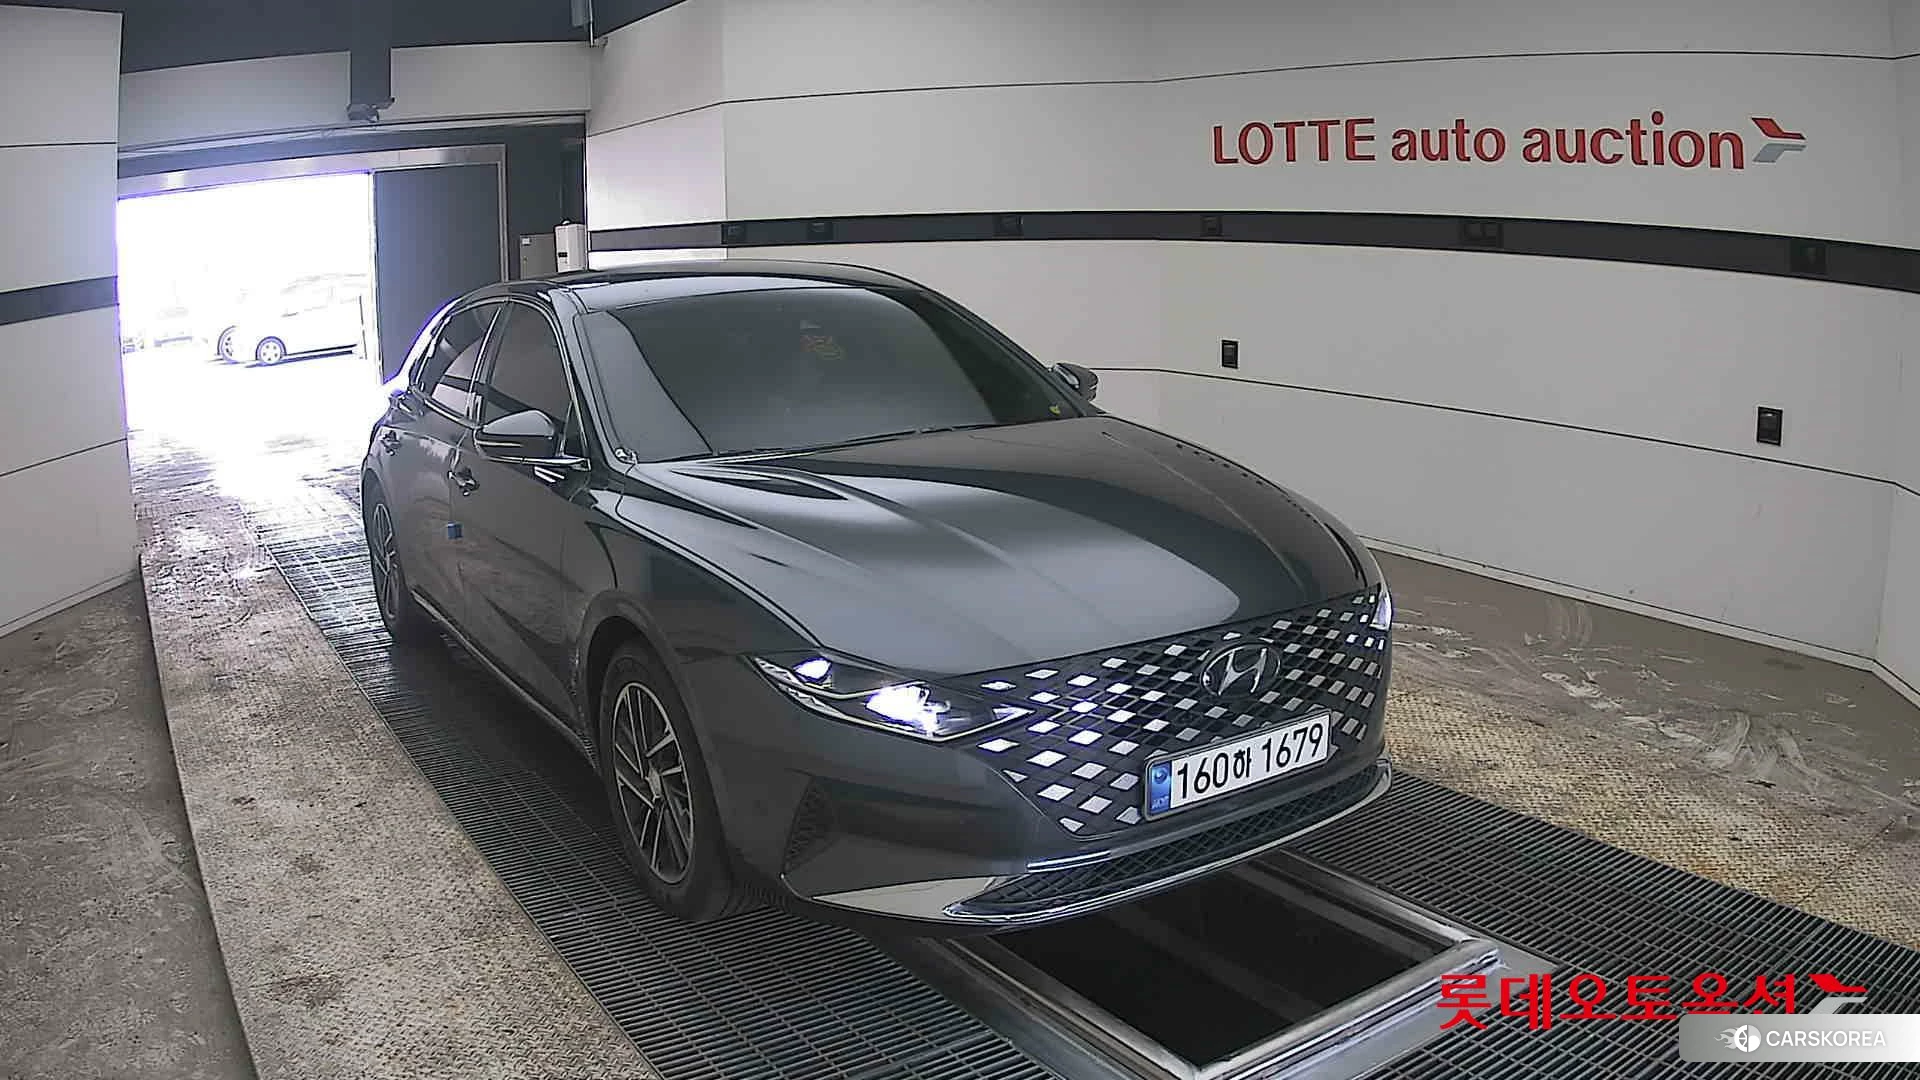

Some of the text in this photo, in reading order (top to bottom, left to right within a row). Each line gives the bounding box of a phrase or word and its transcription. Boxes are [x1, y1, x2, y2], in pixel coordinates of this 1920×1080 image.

[1212, 111, 1746, 170] LOTTE auto auction
[1177, 722, 1324, 799] 160하 1679
